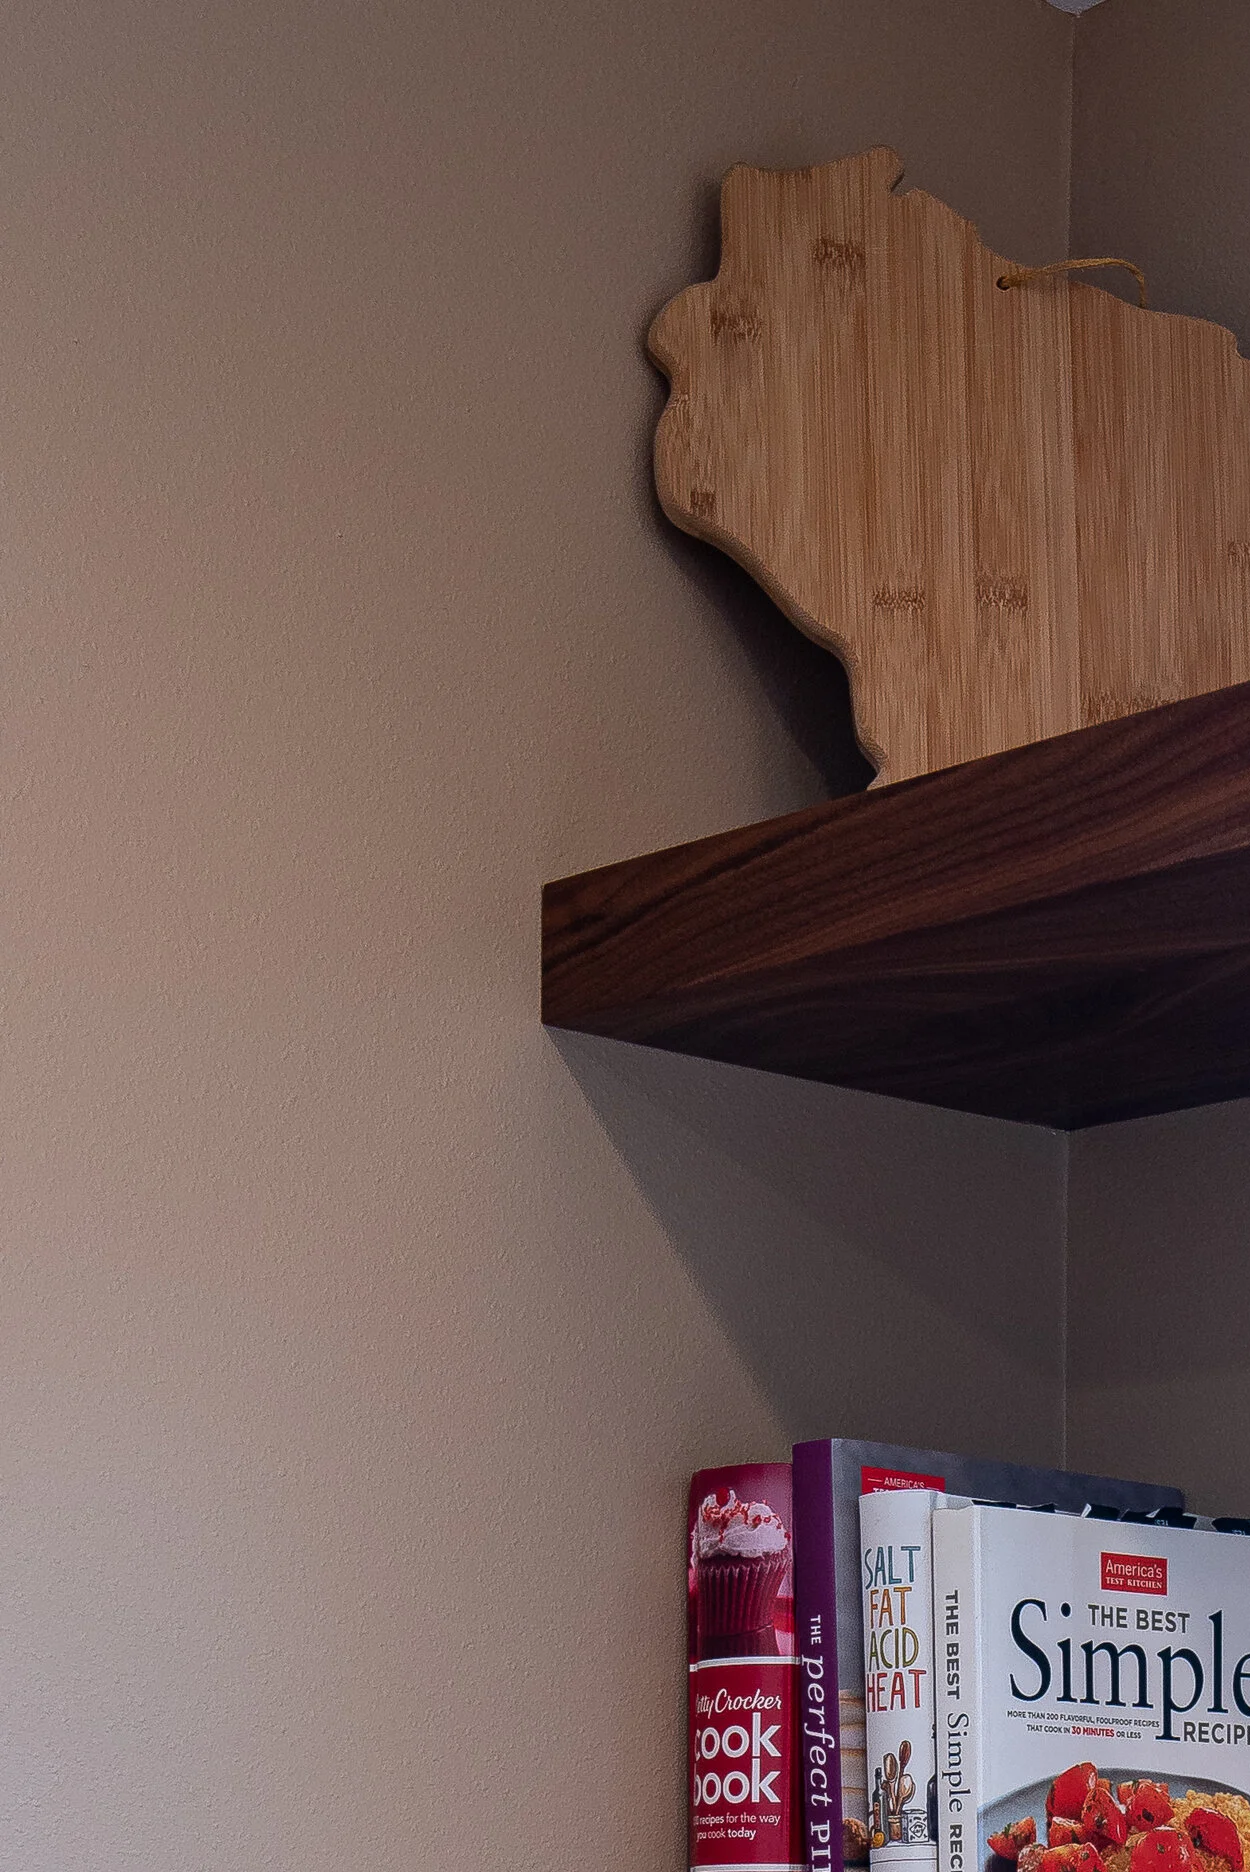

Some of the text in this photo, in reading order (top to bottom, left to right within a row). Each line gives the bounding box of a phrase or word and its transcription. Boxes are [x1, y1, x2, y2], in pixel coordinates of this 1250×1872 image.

[884, 1477, 925, 1489] AMERICA'S
[865, 1545, 921, 1589] SALT
[1105, 1559, 1163, 1579] America's
[1105, 1576, 1163, 1589] TEST KITCHEN
[870, 1586, 912, 1629] FAT
[946, 1589, 959, 1636] THE
[1088, 1604, 1190, 1634] THE BEST
[808, 1614, 821, 1645] THE
[869, 1627, 919, 1672] ACID
[946, 1642, 960, 1700] BEST
[714, 1688, 782, 1713] Crocker
[866, 1669, 926, 1713] HEAT
[801, 1654, 835, 1807] perfect
[1007, 1710, 1160, 1728] MORE THAN 200 FLAVORFUL, FOOLPROOF RECIPES
[1026, 1724, 1142, 1739] THAT COOK IN 30 MINUTES OR LESS
[942, 1712, 972, 1813] Simple
[699, 1814, 725, 1827] recipes
[726, 1812, 738, 1824] for
[740, 1812, 757, 1824] the
[759, 1814, 781, 1826] way
[708, 1828, 726, 1839] cook
[727, 1827, 756, 1840] today
